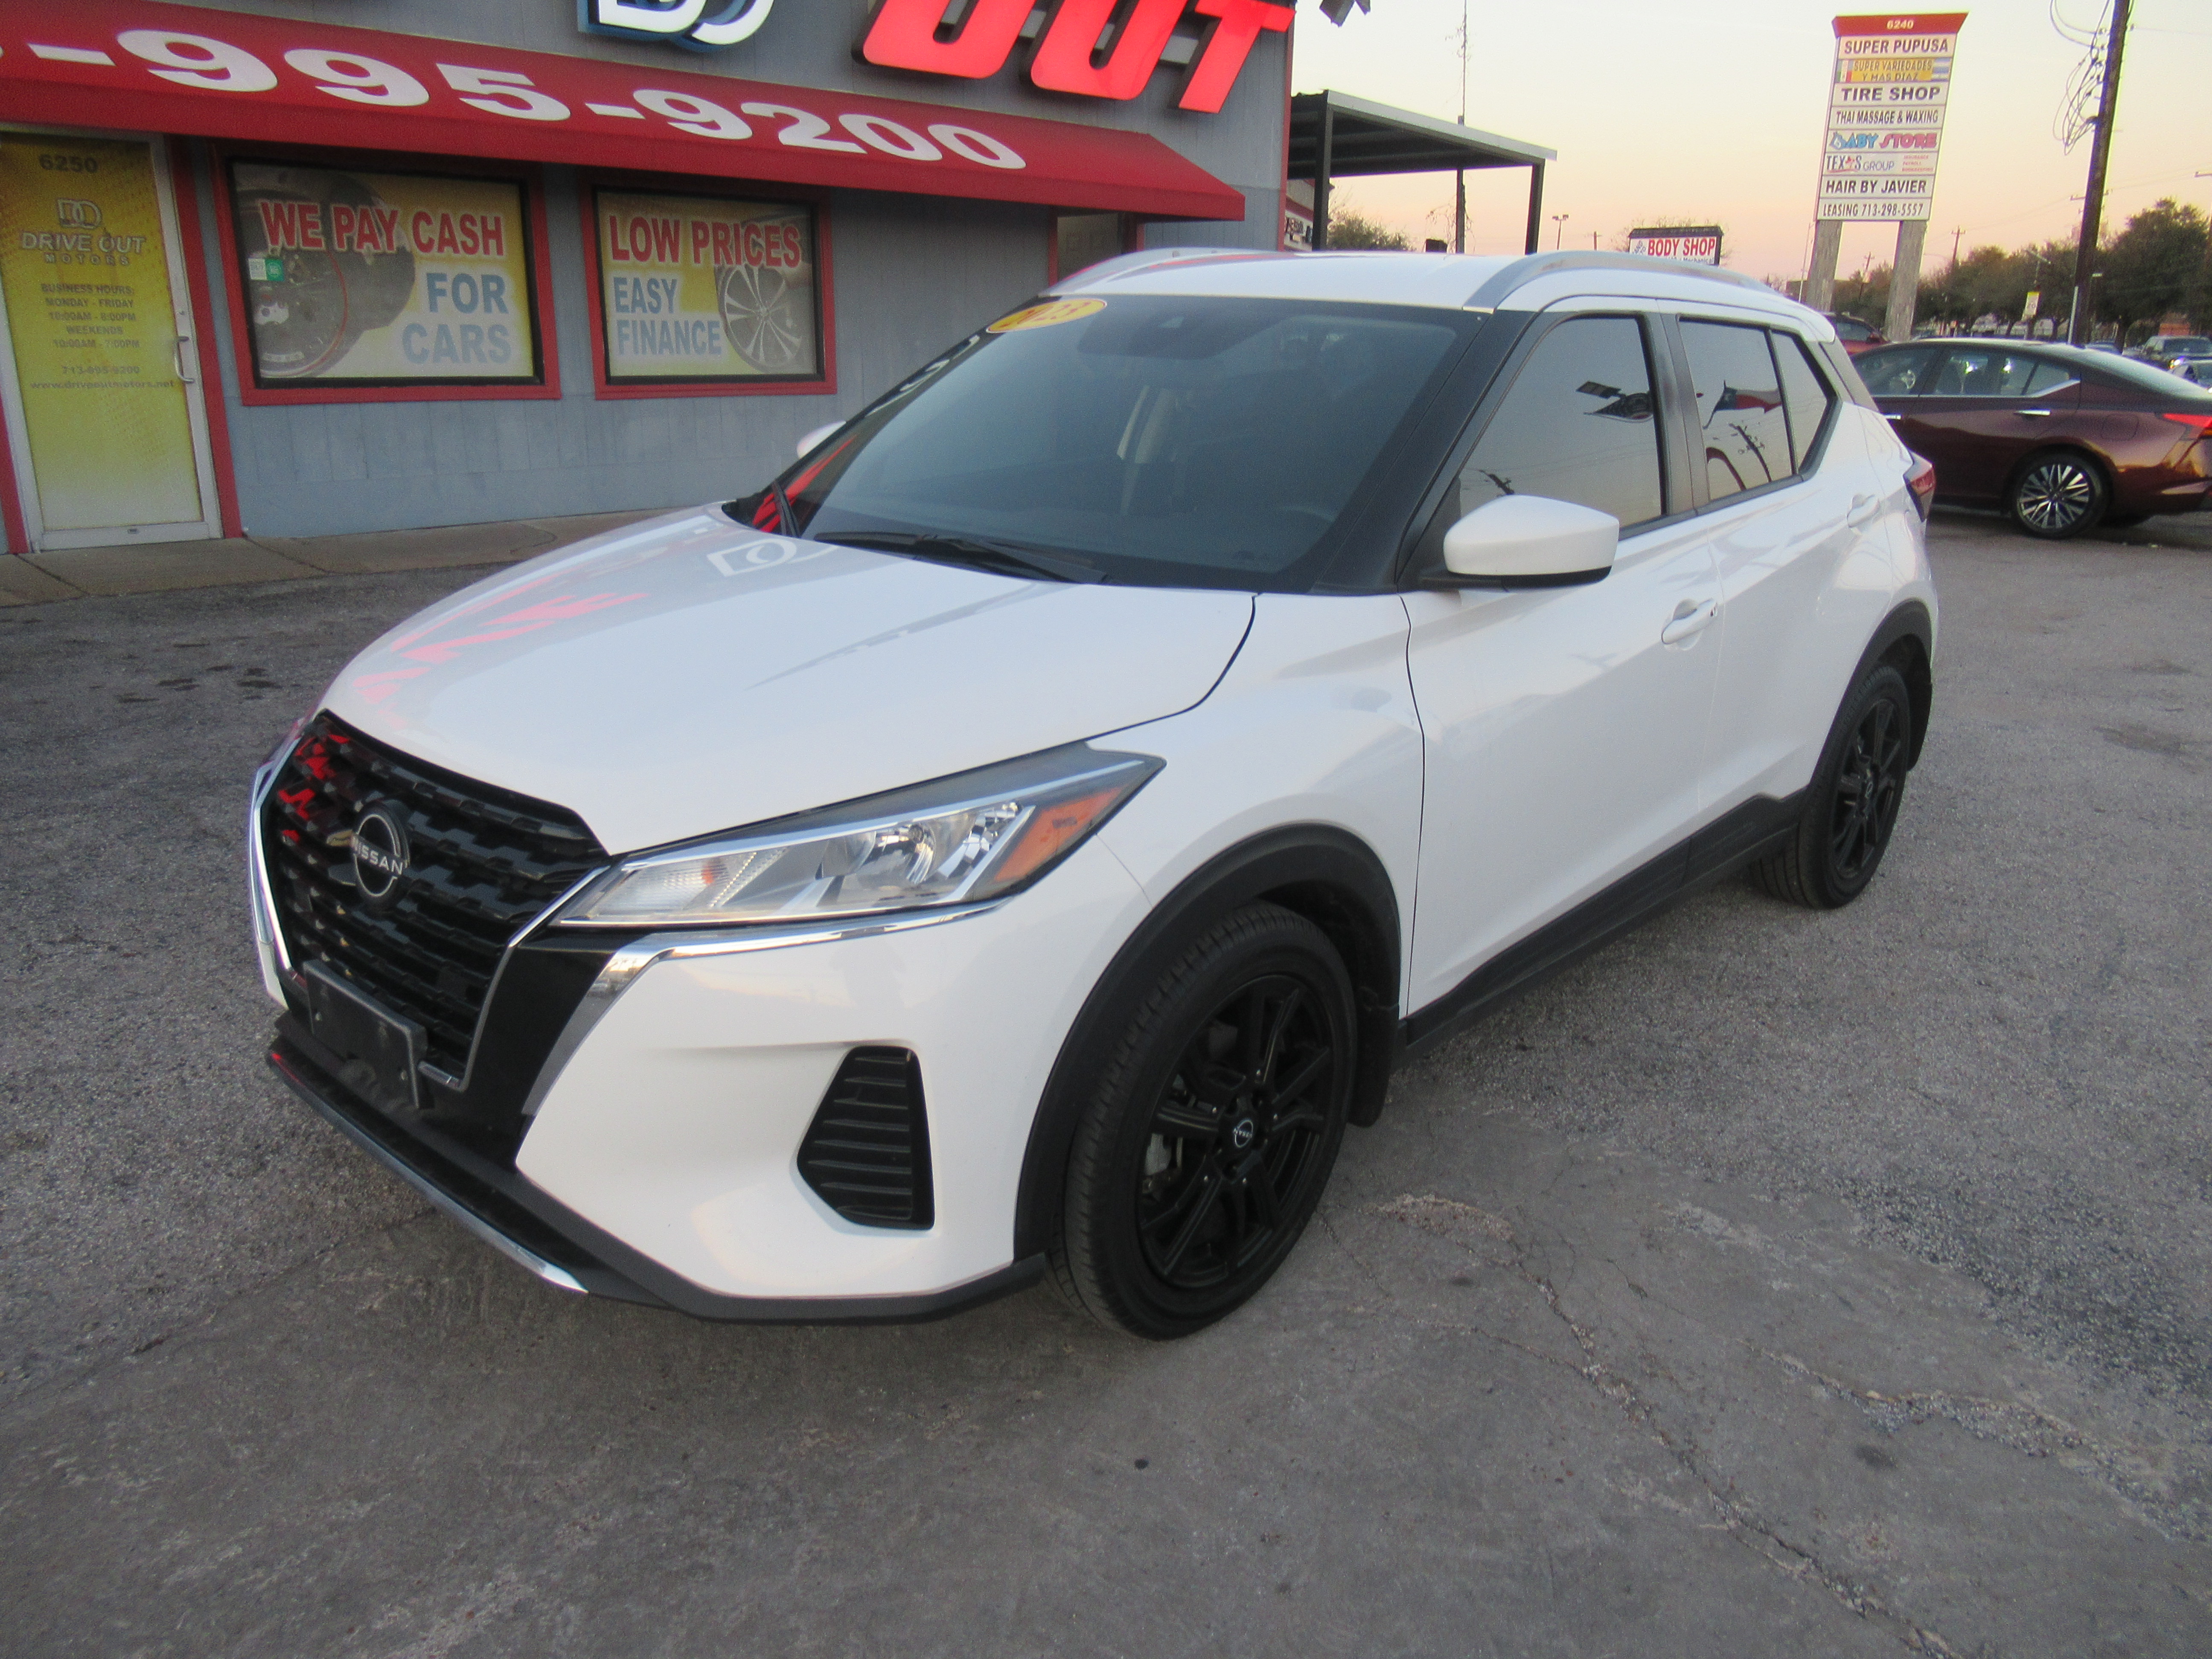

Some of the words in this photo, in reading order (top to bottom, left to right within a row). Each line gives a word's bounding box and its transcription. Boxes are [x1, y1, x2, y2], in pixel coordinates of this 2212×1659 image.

[1887, 20, 1914, 30] 6240
[1844, 40, 1889, 54] SUPER
[1893, 38, 1948, 53] PUPUSA
[1854, 60, 1880, 72] SUPER
[1882, 59, 1932, 71] VARIEDADES
[0, 29, 1026, 169] -995-9200
[1841, 87, 1883, 102] TIRE
[1889, 86, 1941, 101] SHOP
[1836, 111, 1855, 124] THAI
[1857, 110, 1895, 124] MASSAGE
[1897, 111, 1903, 123] &
[1906, 109, 1939, 123] WAXING
[1879, 133, 1937, 149] STORE
[39, 154, 98, 173] 6250
[1863, 160, 1895, 171] GROUP
[1826, 180, 1857, 194] HAIR
[1860, 180, 1877, 194] BY
[1881, 180, 1927, 194] JAVIER
[1823, 203, 1859, 217] LEASING
[1861, 203, 1924, 217] 713-298-5557
[260, 201, 324, 249] WE
[331, 205, 399, 252] PAY
[412, 211, 504, 256] CASH
[22, 231, 92, 252] DRIVE
[98, 235, 146, 254] OUT
[608, 215, 681, 263] LOW
[690, 220, 801, 268] PRICES
[1647, 239, 1680, 256] BODY
[1683, 238, 1715, 256] SHOP
[45, 252, 129, 266] MOTORS
[41, 284, 93, 294] BUSINESS
[426, 272, 509, 314] FOR
[613, 276, 678, 314] EASY
[45, 298, 89, 307] MONDAY
[98, 299, 134, 308] FRIDAY
[66, 326, 124, 335] WEEKENDS
[616, 320, 722, 356] FINANCE
[402, 323, 511, 364] CARS
[352, 835, 403, 875] NISSAN
